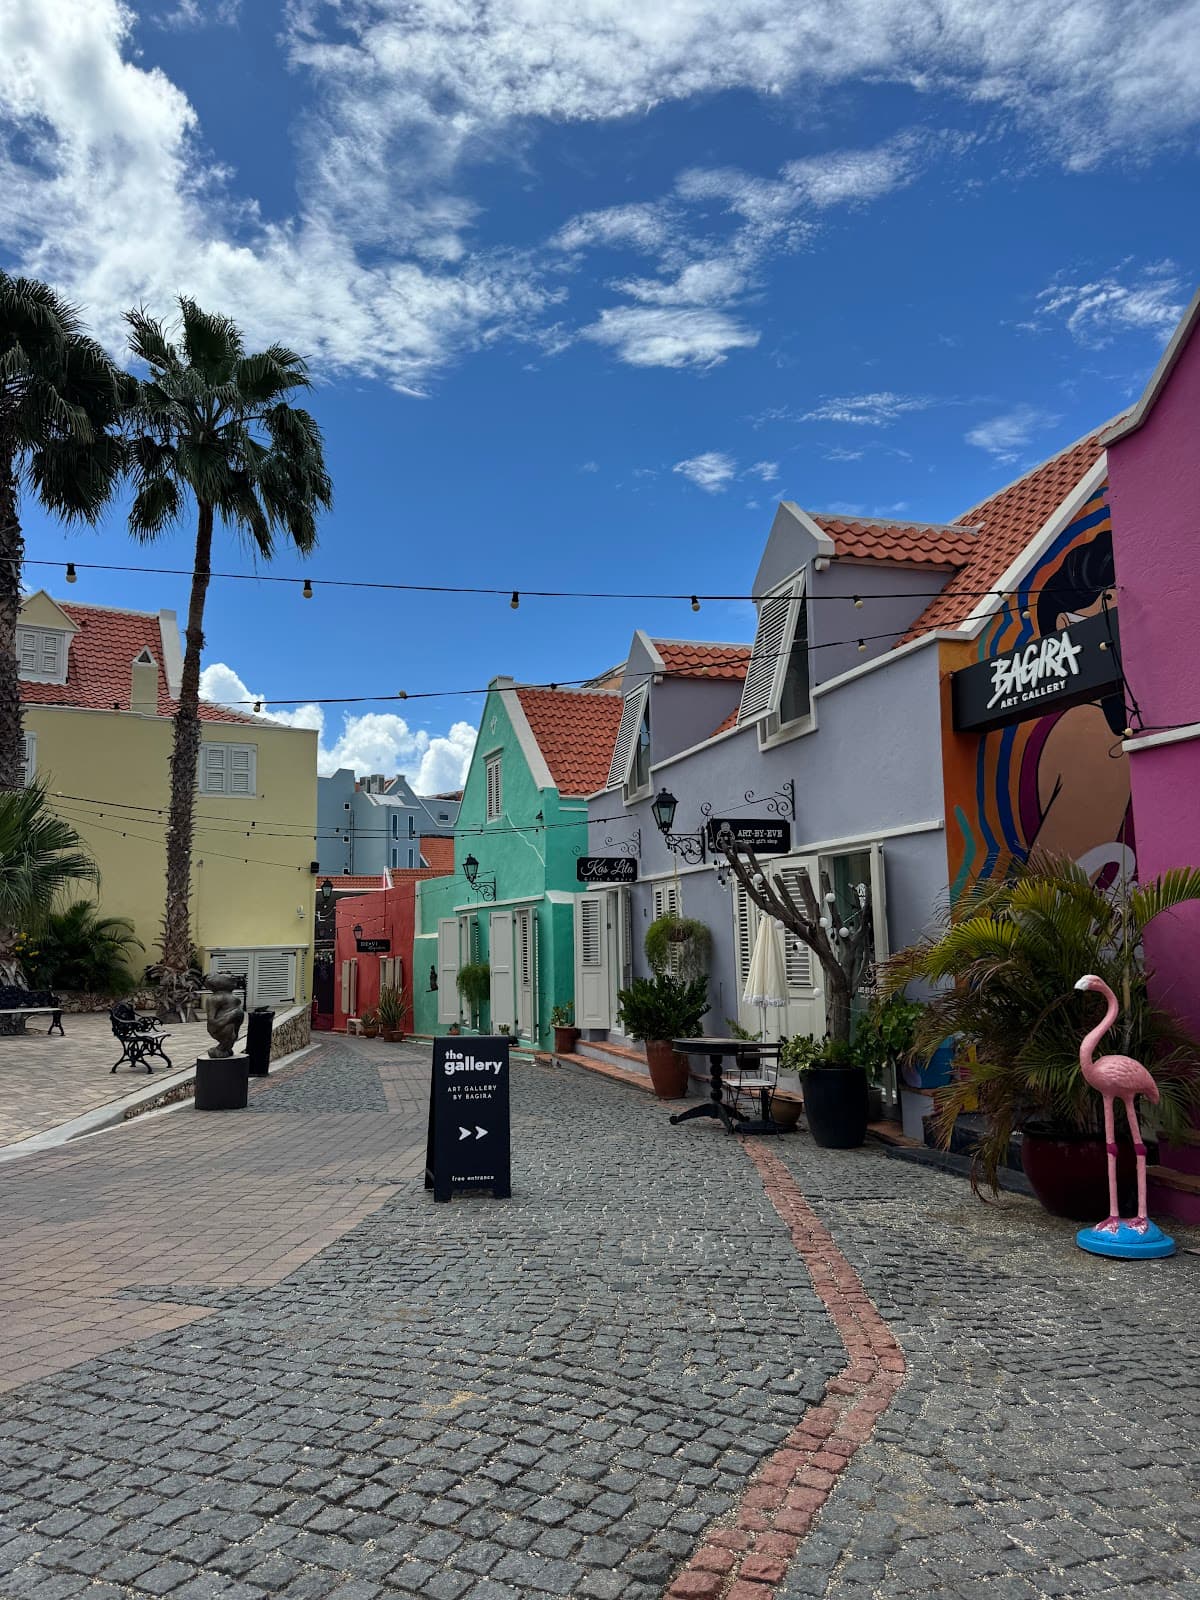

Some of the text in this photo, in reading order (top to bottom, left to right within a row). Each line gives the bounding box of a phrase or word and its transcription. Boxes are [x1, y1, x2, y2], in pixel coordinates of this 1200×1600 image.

[986, 631, 1082, 709] BAGIRA
[1000, 680, 1066, 709] ART GALLERY
[737, 829, 783, 838] ART-BY-EVE
[580, 858, 609, 876] Kas
[445, 1049, 464, 1060] the
[444, 1055, 503, 1075] gallery
[464, 1084, 497, 1092] GALLERY
